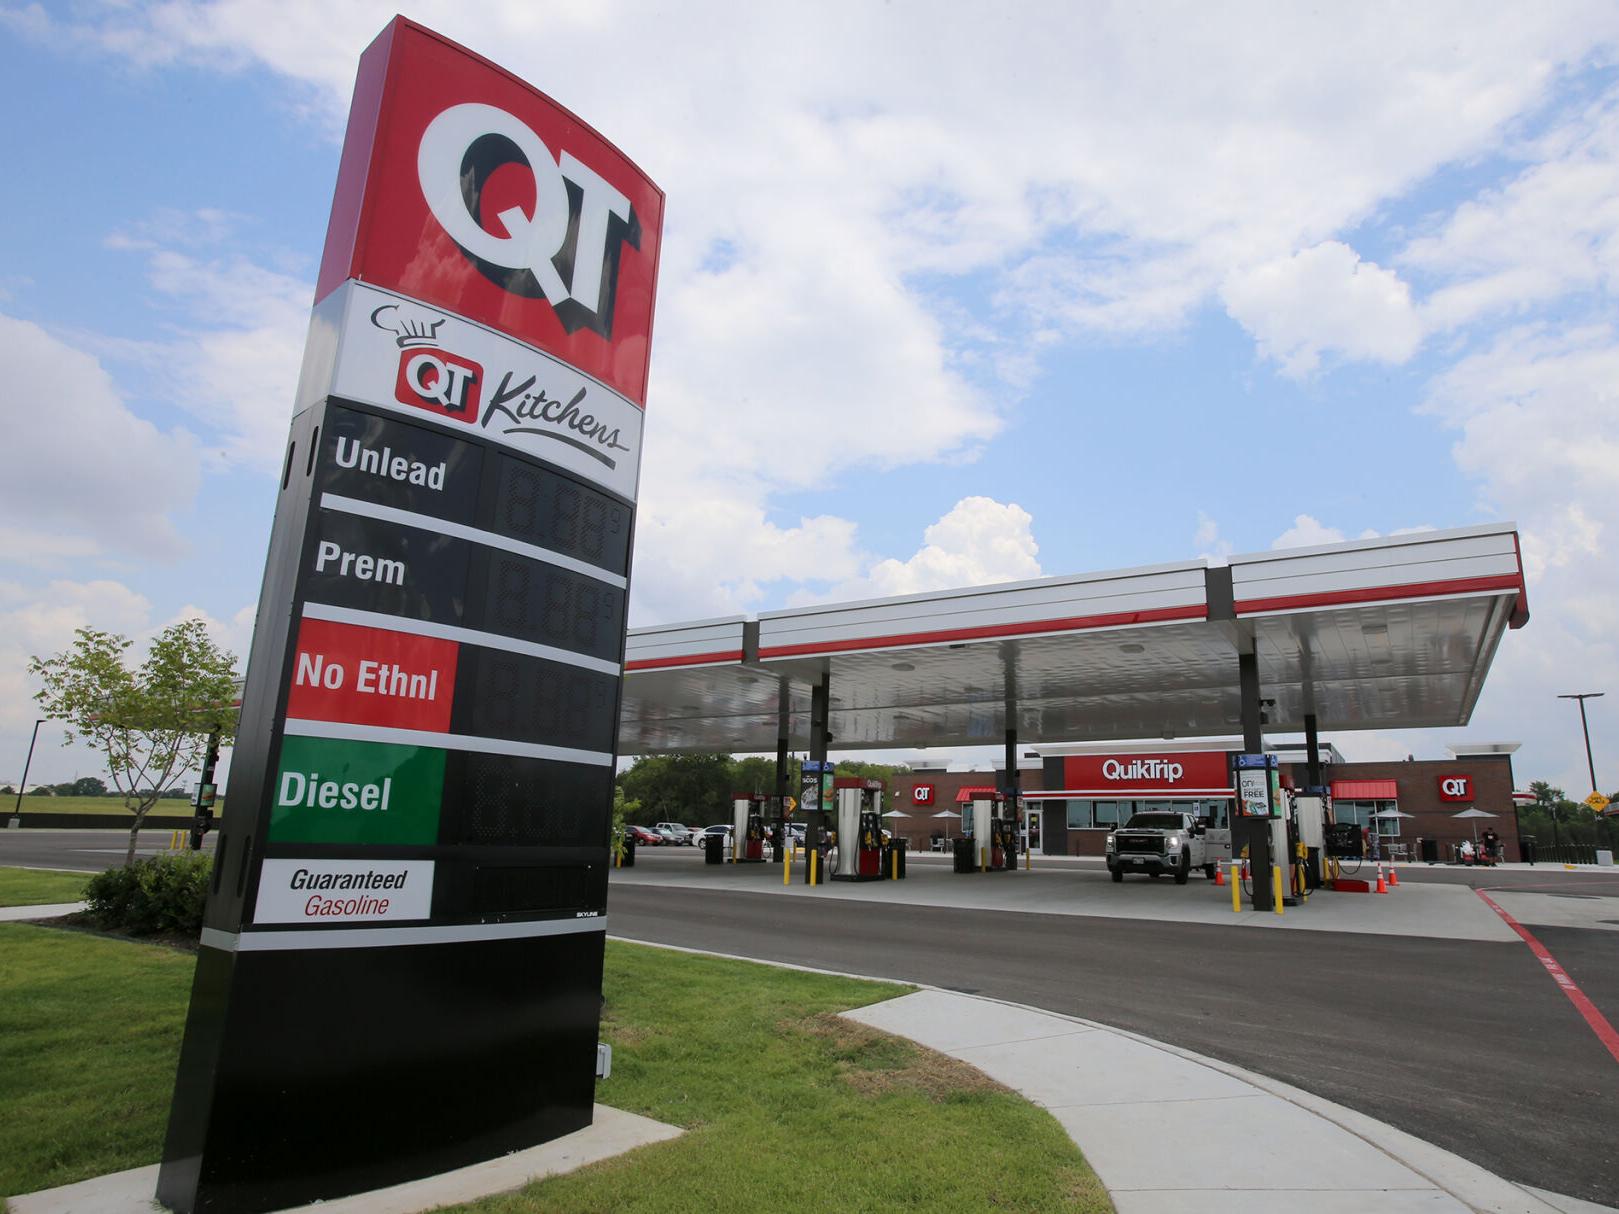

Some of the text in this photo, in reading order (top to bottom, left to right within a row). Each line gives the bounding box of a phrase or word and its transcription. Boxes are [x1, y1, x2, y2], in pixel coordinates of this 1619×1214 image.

[417, 102, 632, 316] QT
[405, 352, 630, 453] QT Kitchens
[335, 436, 447, 492] Unlead
[315, 540, 406, 586] Prem
[295, 652, 438, 701] No Ethnl
[278, 771, 391, 811] Diesel
[1102, 759, 1184, 783] QuikTrip
[1442, 778, 1467, 797] QT
[914, 786, 931, 801] QT
[290, 869, 408, 890] Guaranteed
[304, 895, 390, 917] Gasoline
